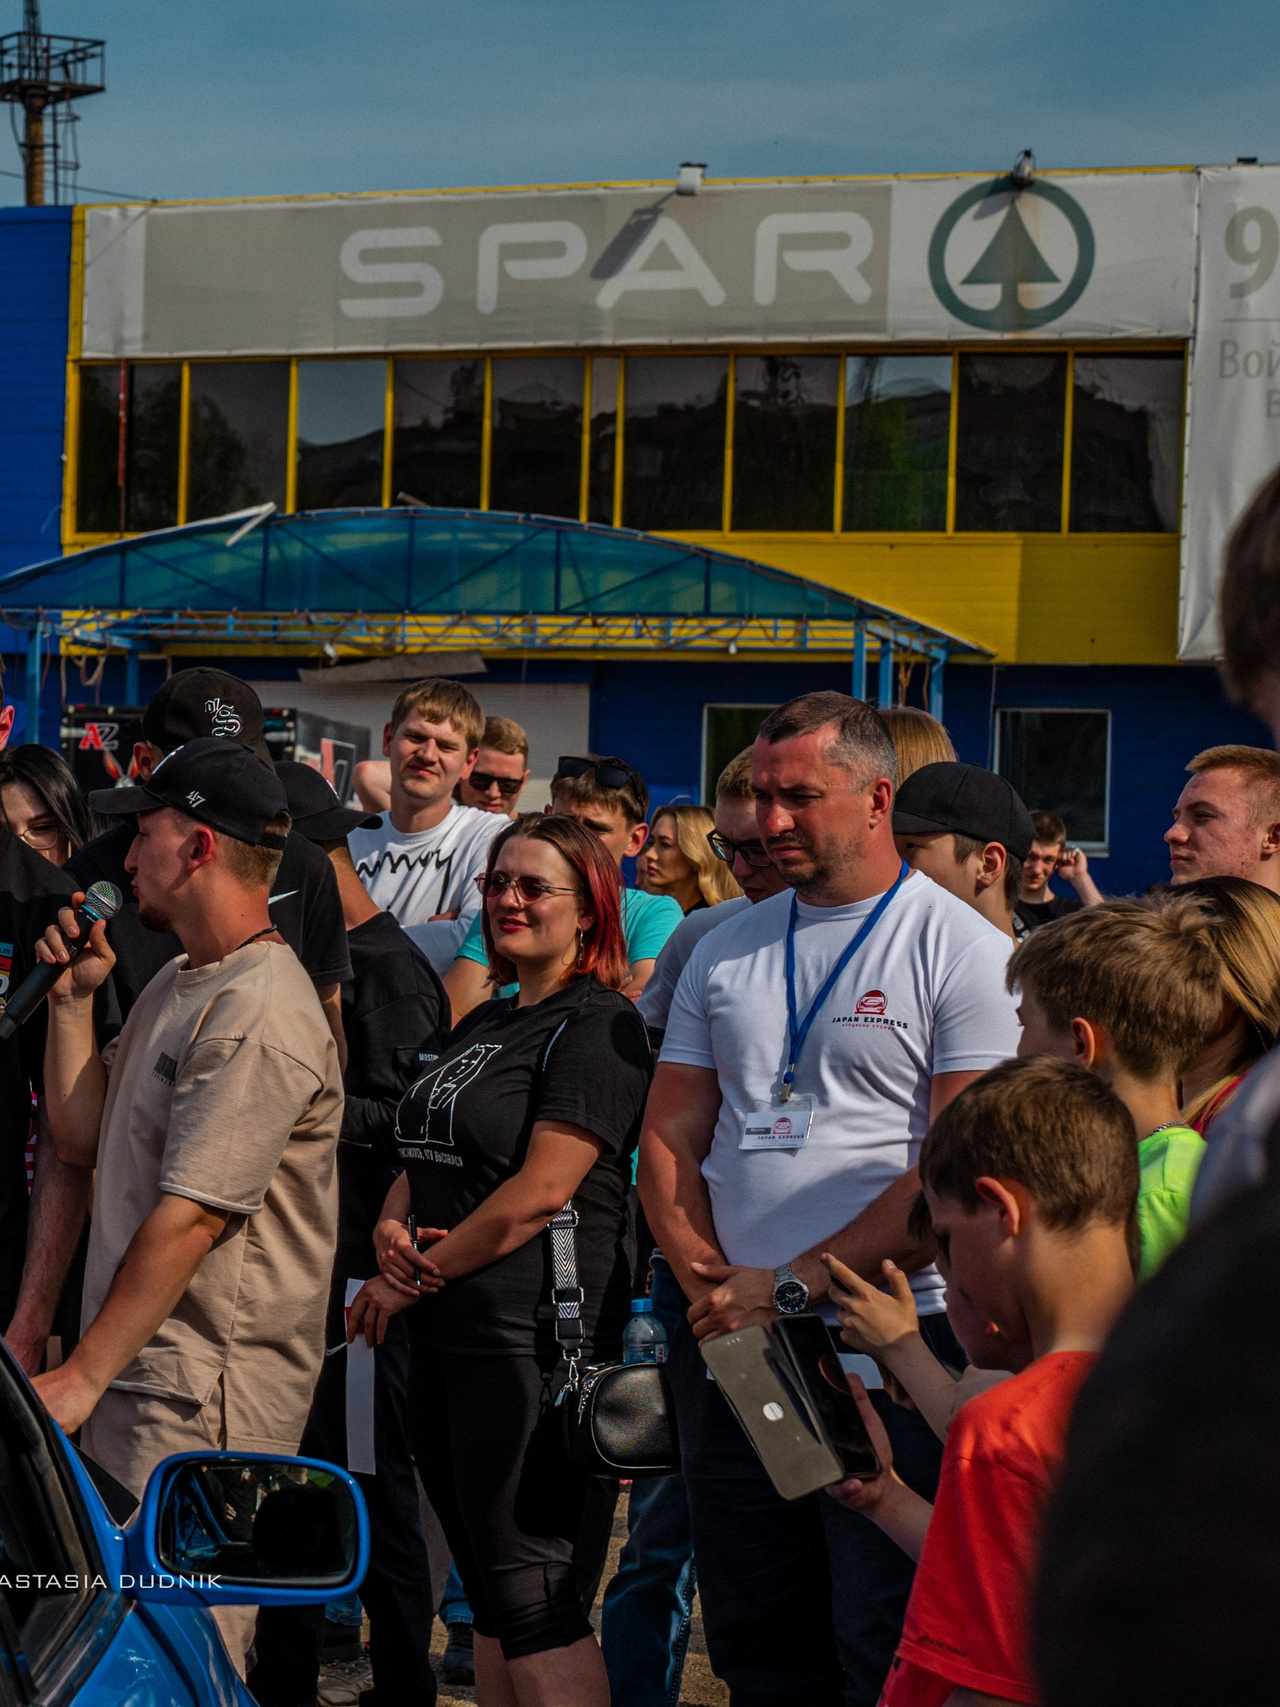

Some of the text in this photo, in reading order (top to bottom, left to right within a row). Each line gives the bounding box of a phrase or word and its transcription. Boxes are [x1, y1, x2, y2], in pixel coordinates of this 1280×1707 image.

[338, 211, 875, 320] SPAR
[832, 1016, 909, 1029] JAPAN EXPRESS
